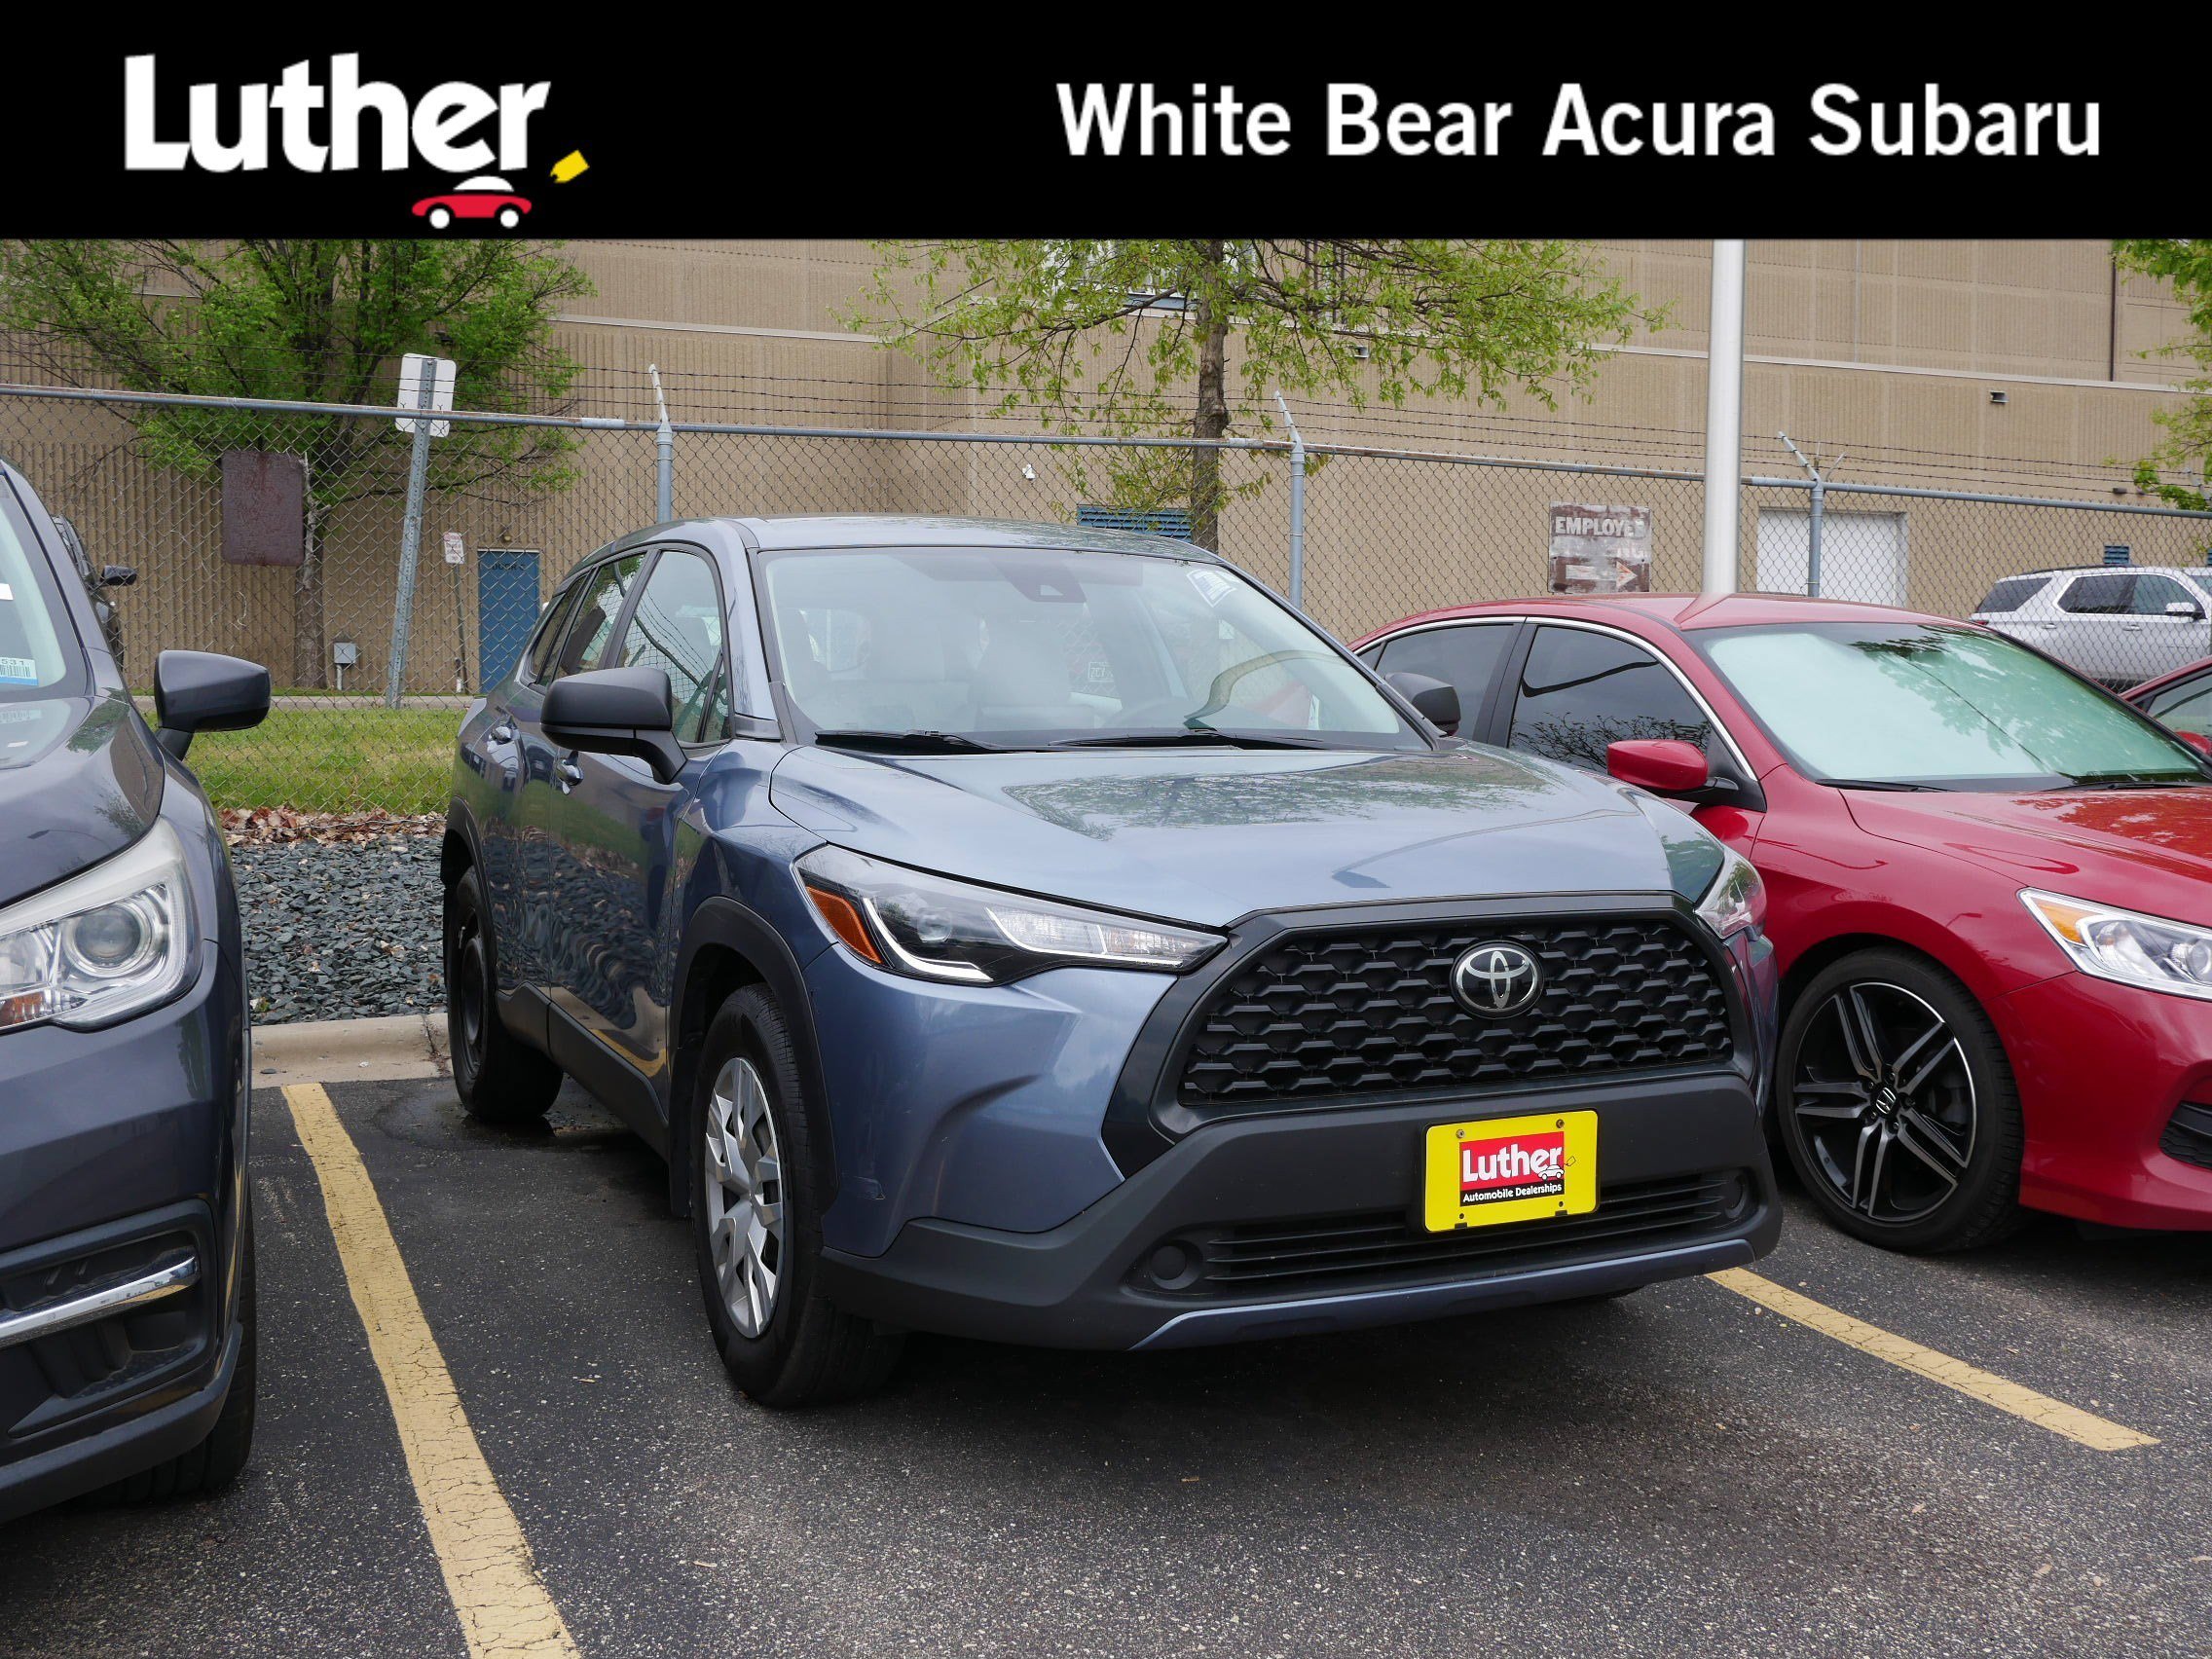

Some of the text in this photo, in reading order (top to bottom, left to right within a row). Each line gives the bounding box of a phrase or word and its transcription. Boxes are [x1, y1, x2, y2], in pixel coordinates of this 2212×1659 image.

[1462, 1144, 1563, 1182] Luther
[1462, 1183, 1563, 1202] Automobile Dealerships
